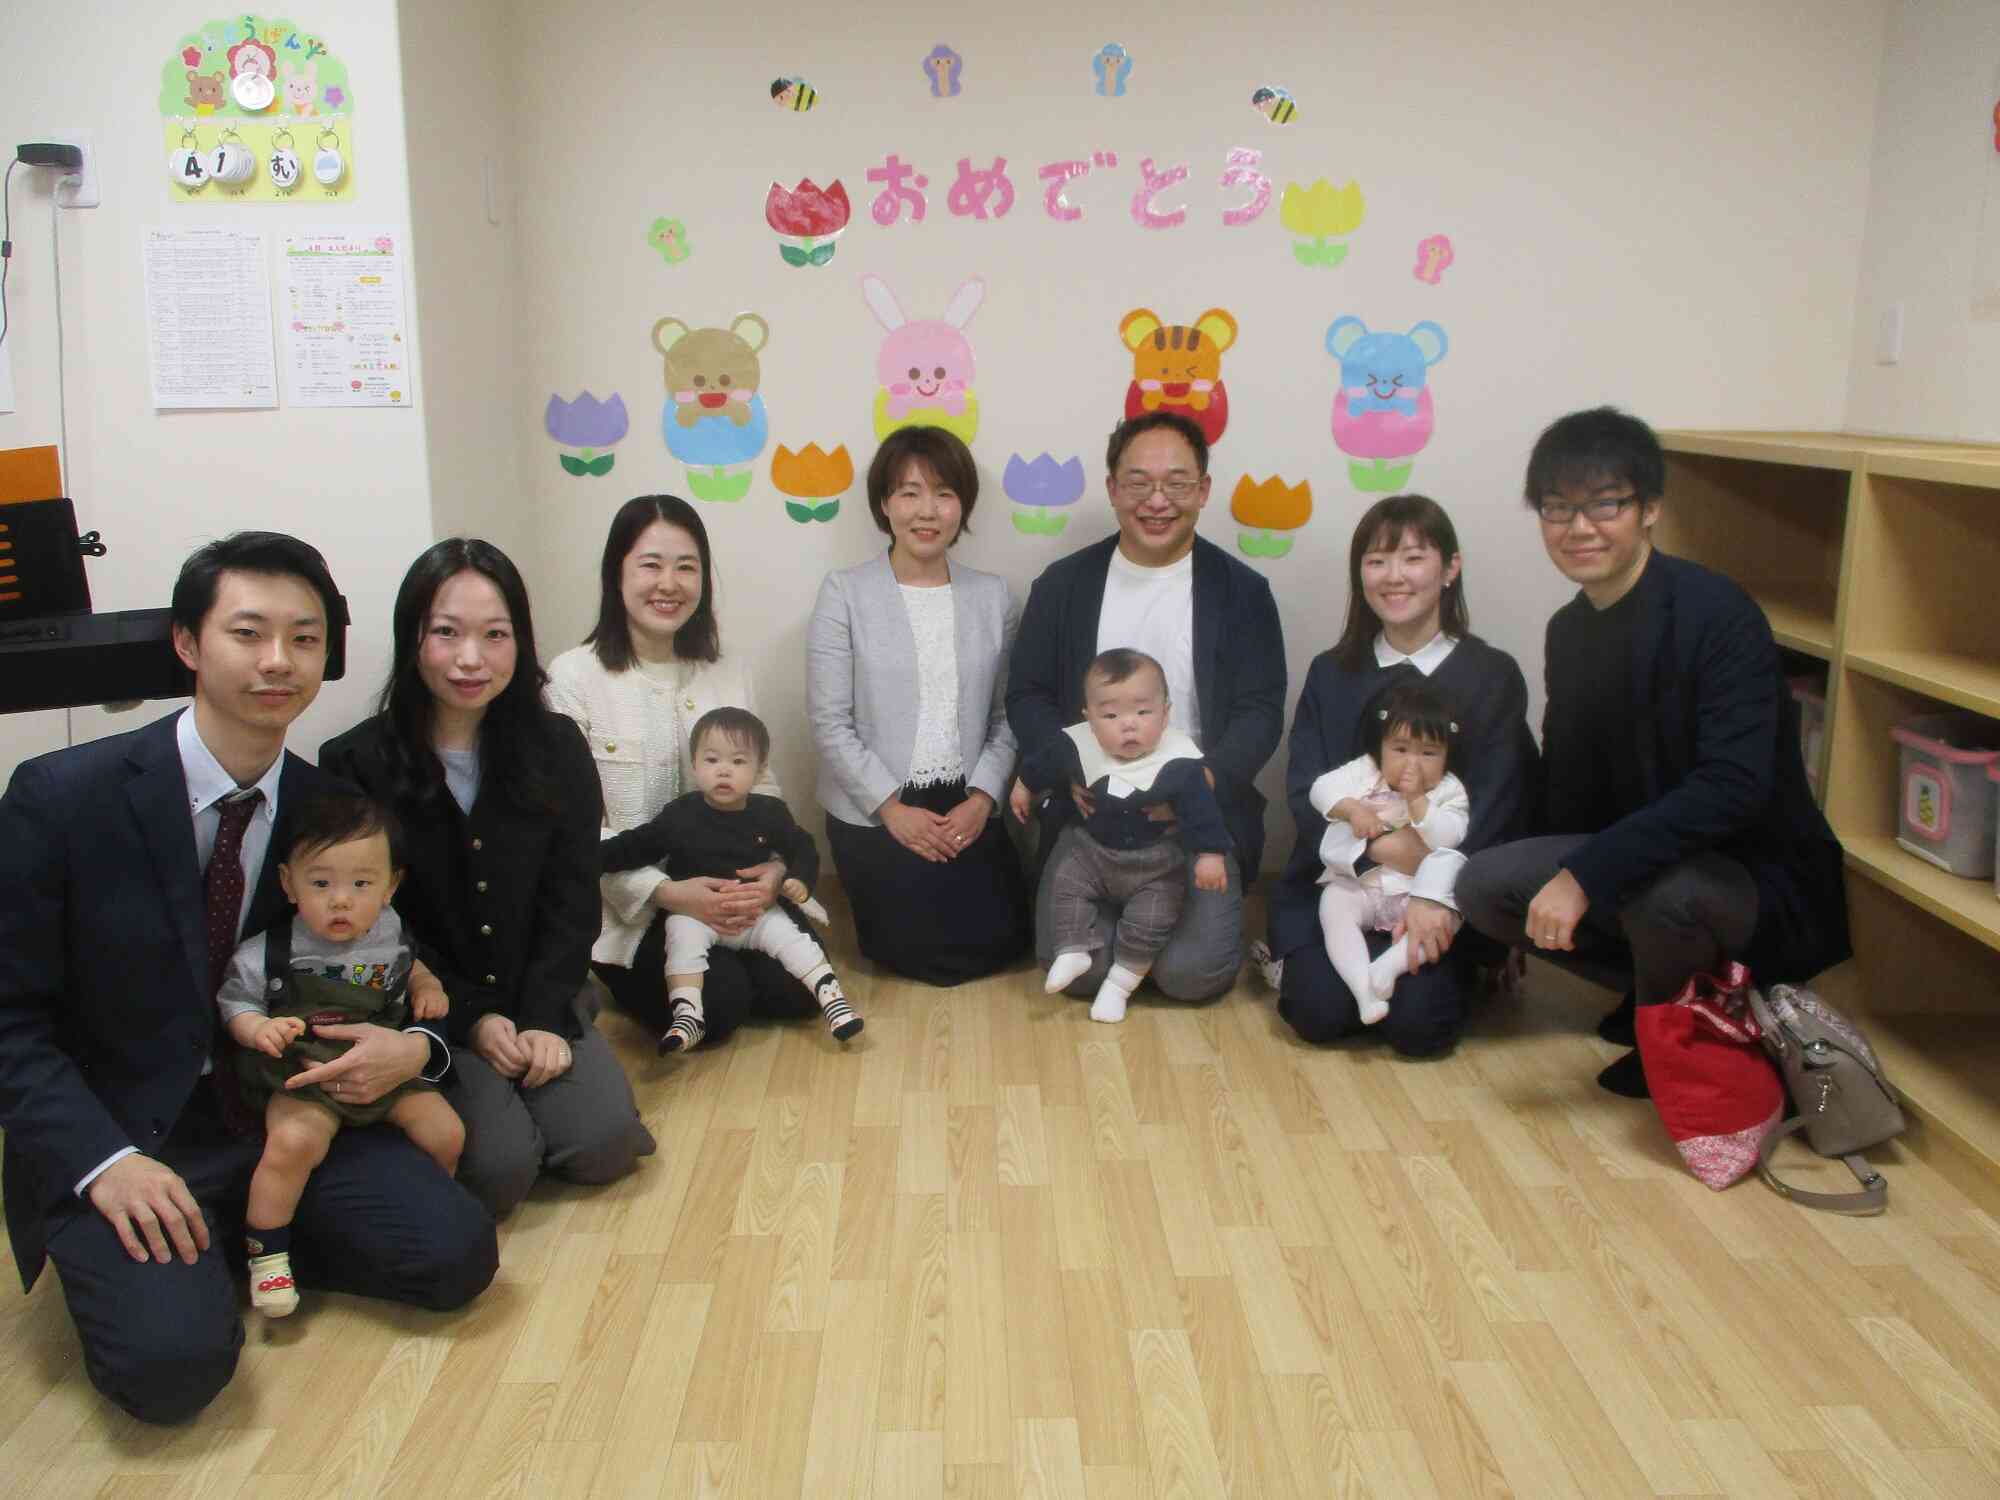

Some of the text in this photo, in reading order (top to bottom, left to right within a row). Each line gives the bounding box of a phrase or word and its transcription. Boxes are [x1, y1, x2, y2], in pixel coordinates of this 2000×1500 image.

[185, 152, 296, 179] 4 1 すい
[866, 147, 1272, 230] おめでとう
